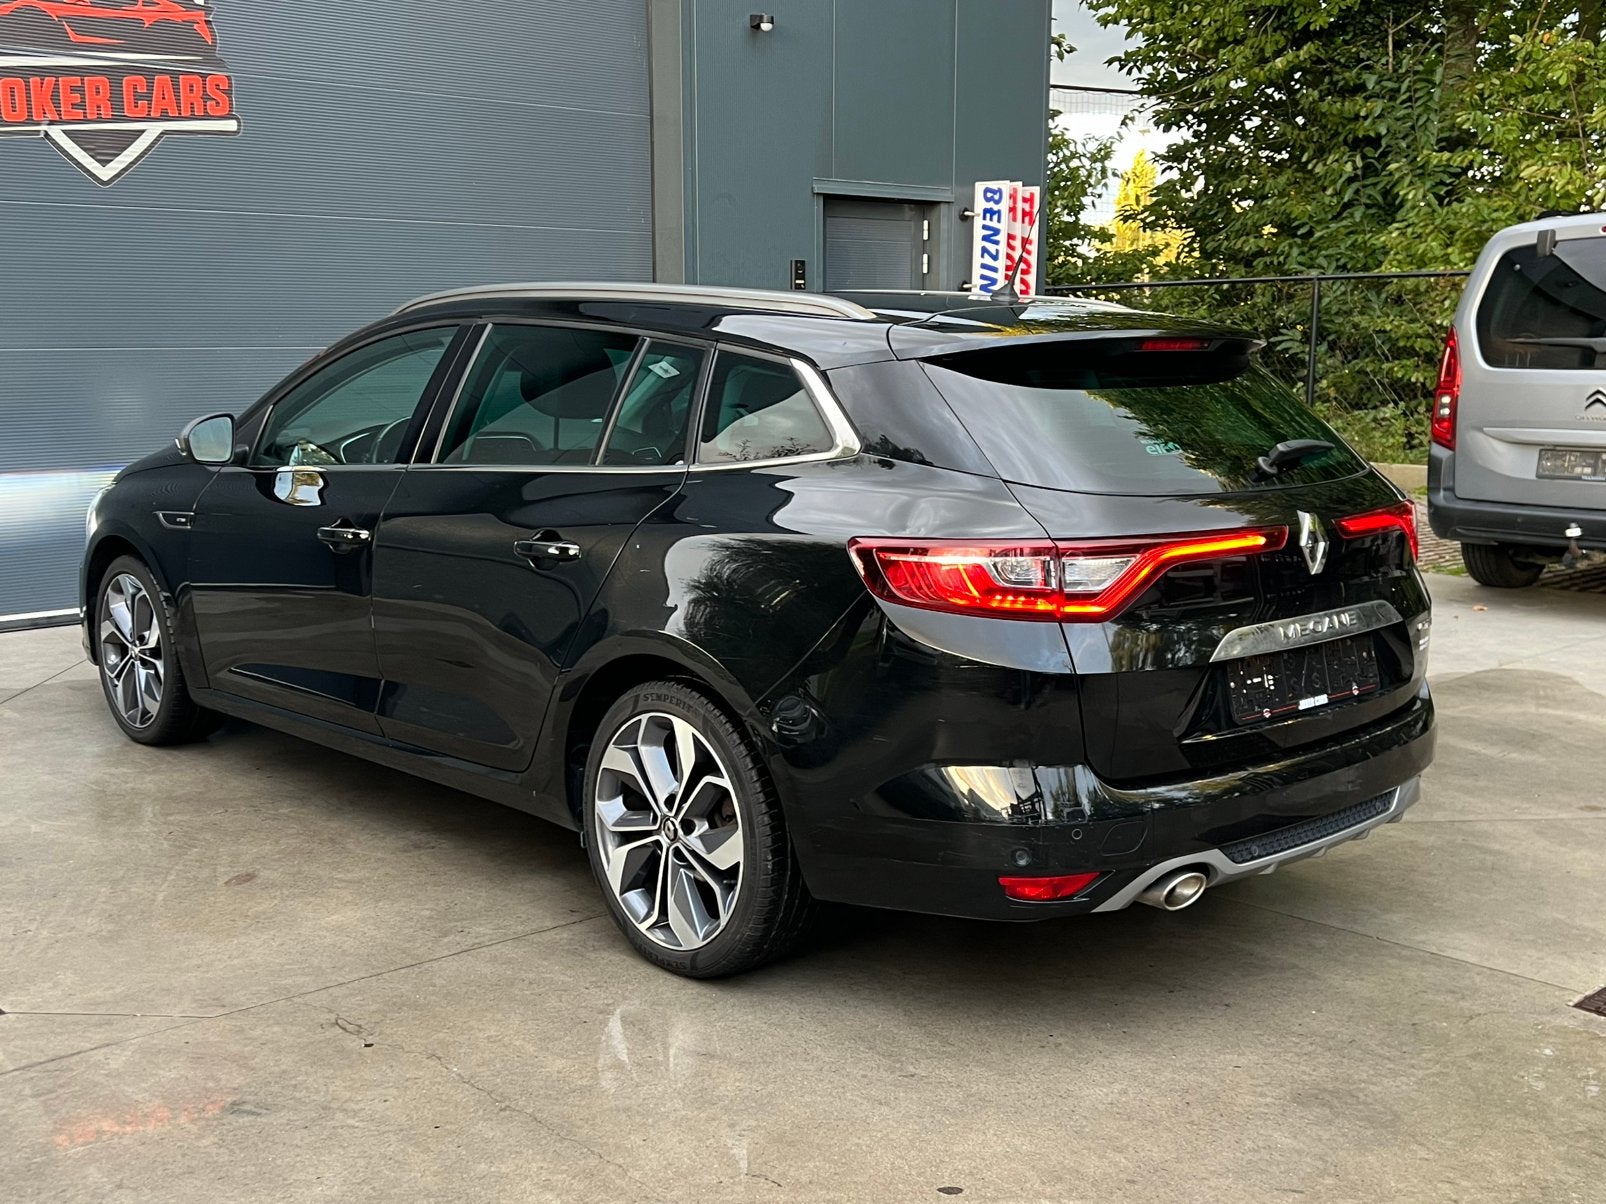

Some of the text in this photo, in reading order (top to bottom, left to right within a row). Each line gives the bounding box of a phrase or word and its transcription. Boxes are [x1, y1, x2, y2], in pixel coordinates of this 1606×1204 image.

[0, 74, 230, 121] OKER CARS
[979, 187, 1003, 294] BENZIN
[1279, 610, 1357, 641] MEGANE
[642, 692, 694, 715] SEMPERIT
